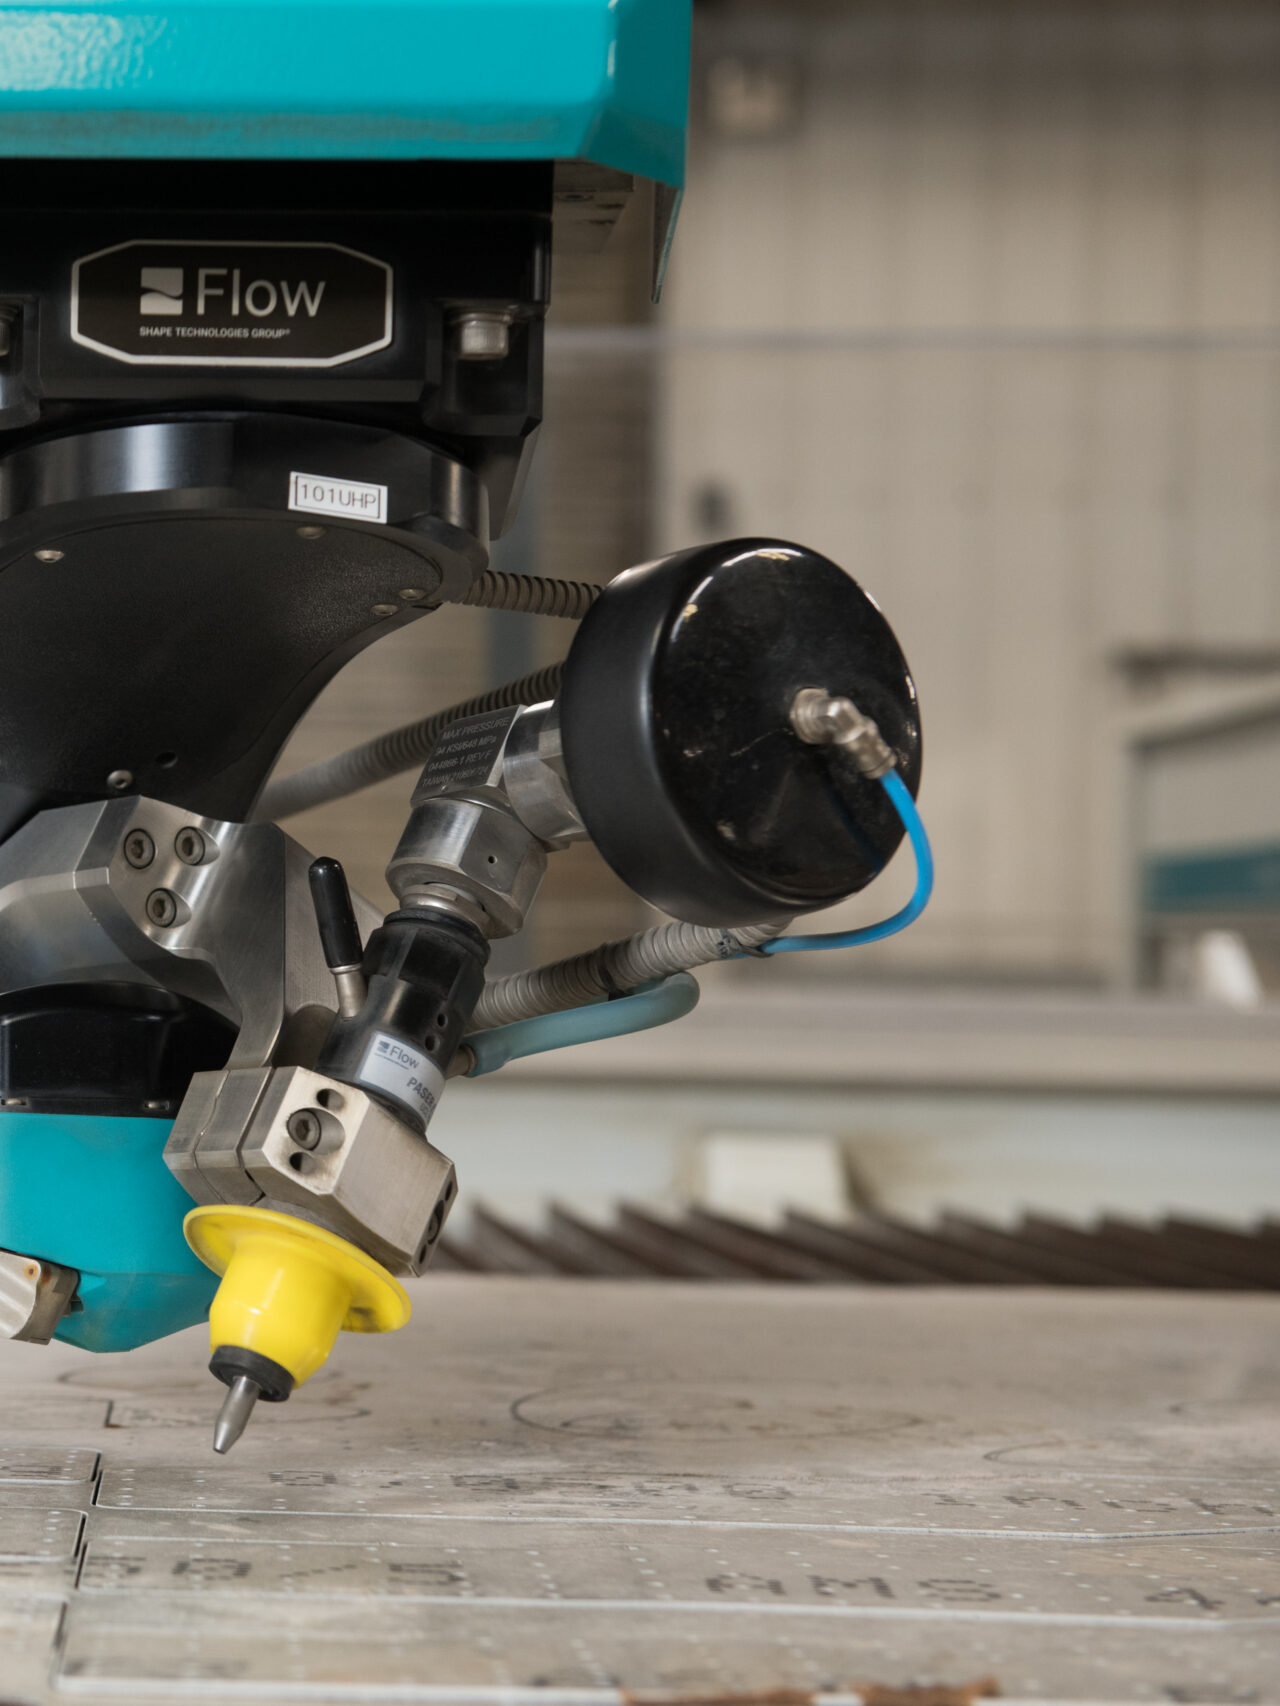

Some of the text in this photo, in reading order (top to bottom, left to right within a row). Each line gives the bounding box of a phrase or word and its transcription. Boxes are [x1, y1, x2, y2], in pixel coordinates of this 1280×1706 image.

[197, 268, 326, 318] Flow
[139, 326, 173, 338] SHAPE
[175, 327, 250, 339] TECHNOLOGIES
[301, 484, 377, 509] 101UHP
[461, 717, 510, 736] PRESSURE
[388, 1045, 420, 1069] Flow
[705, 1573, 1003, 1603] AMS
